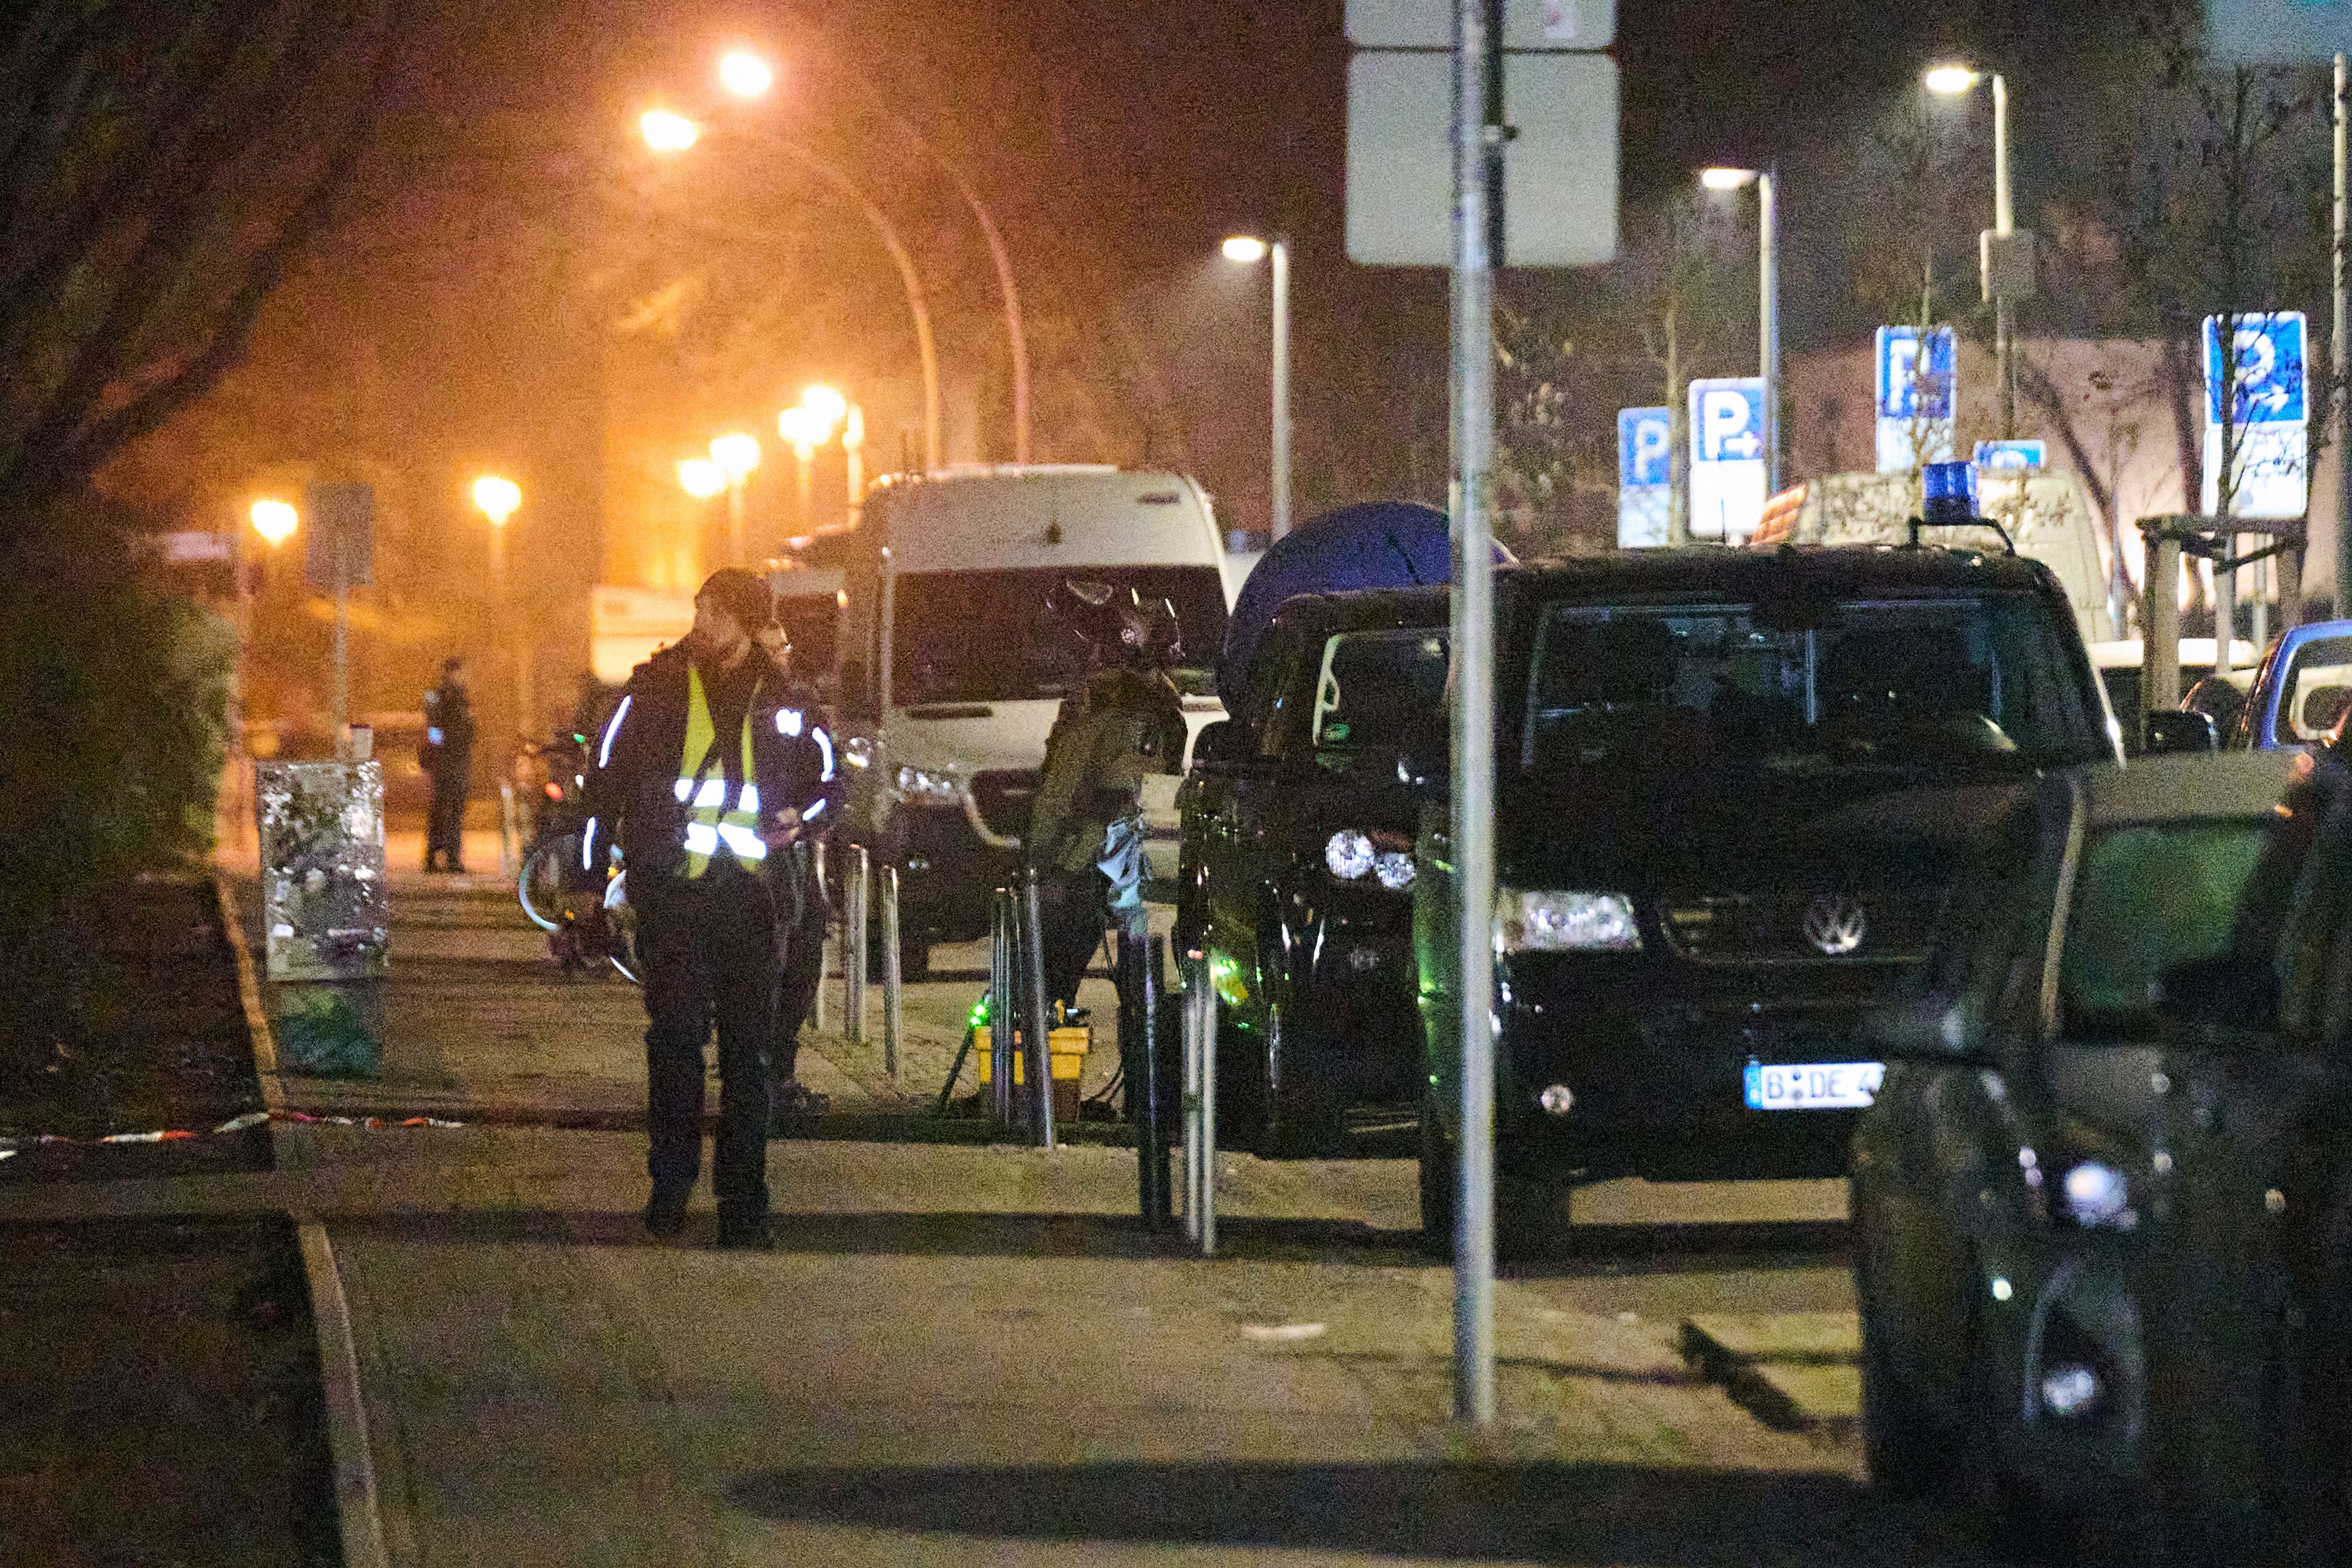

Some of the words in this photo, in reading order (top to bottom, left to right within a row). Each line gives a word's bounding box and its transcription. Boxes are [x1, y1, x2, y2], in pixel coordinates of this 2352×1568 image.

[1634, 419, 1669, 480] P
[1705, 390, 1750, 460] P
[1766, 1071, 1783, 1100] B
[1809, 1069, 1847, 1099] DE
